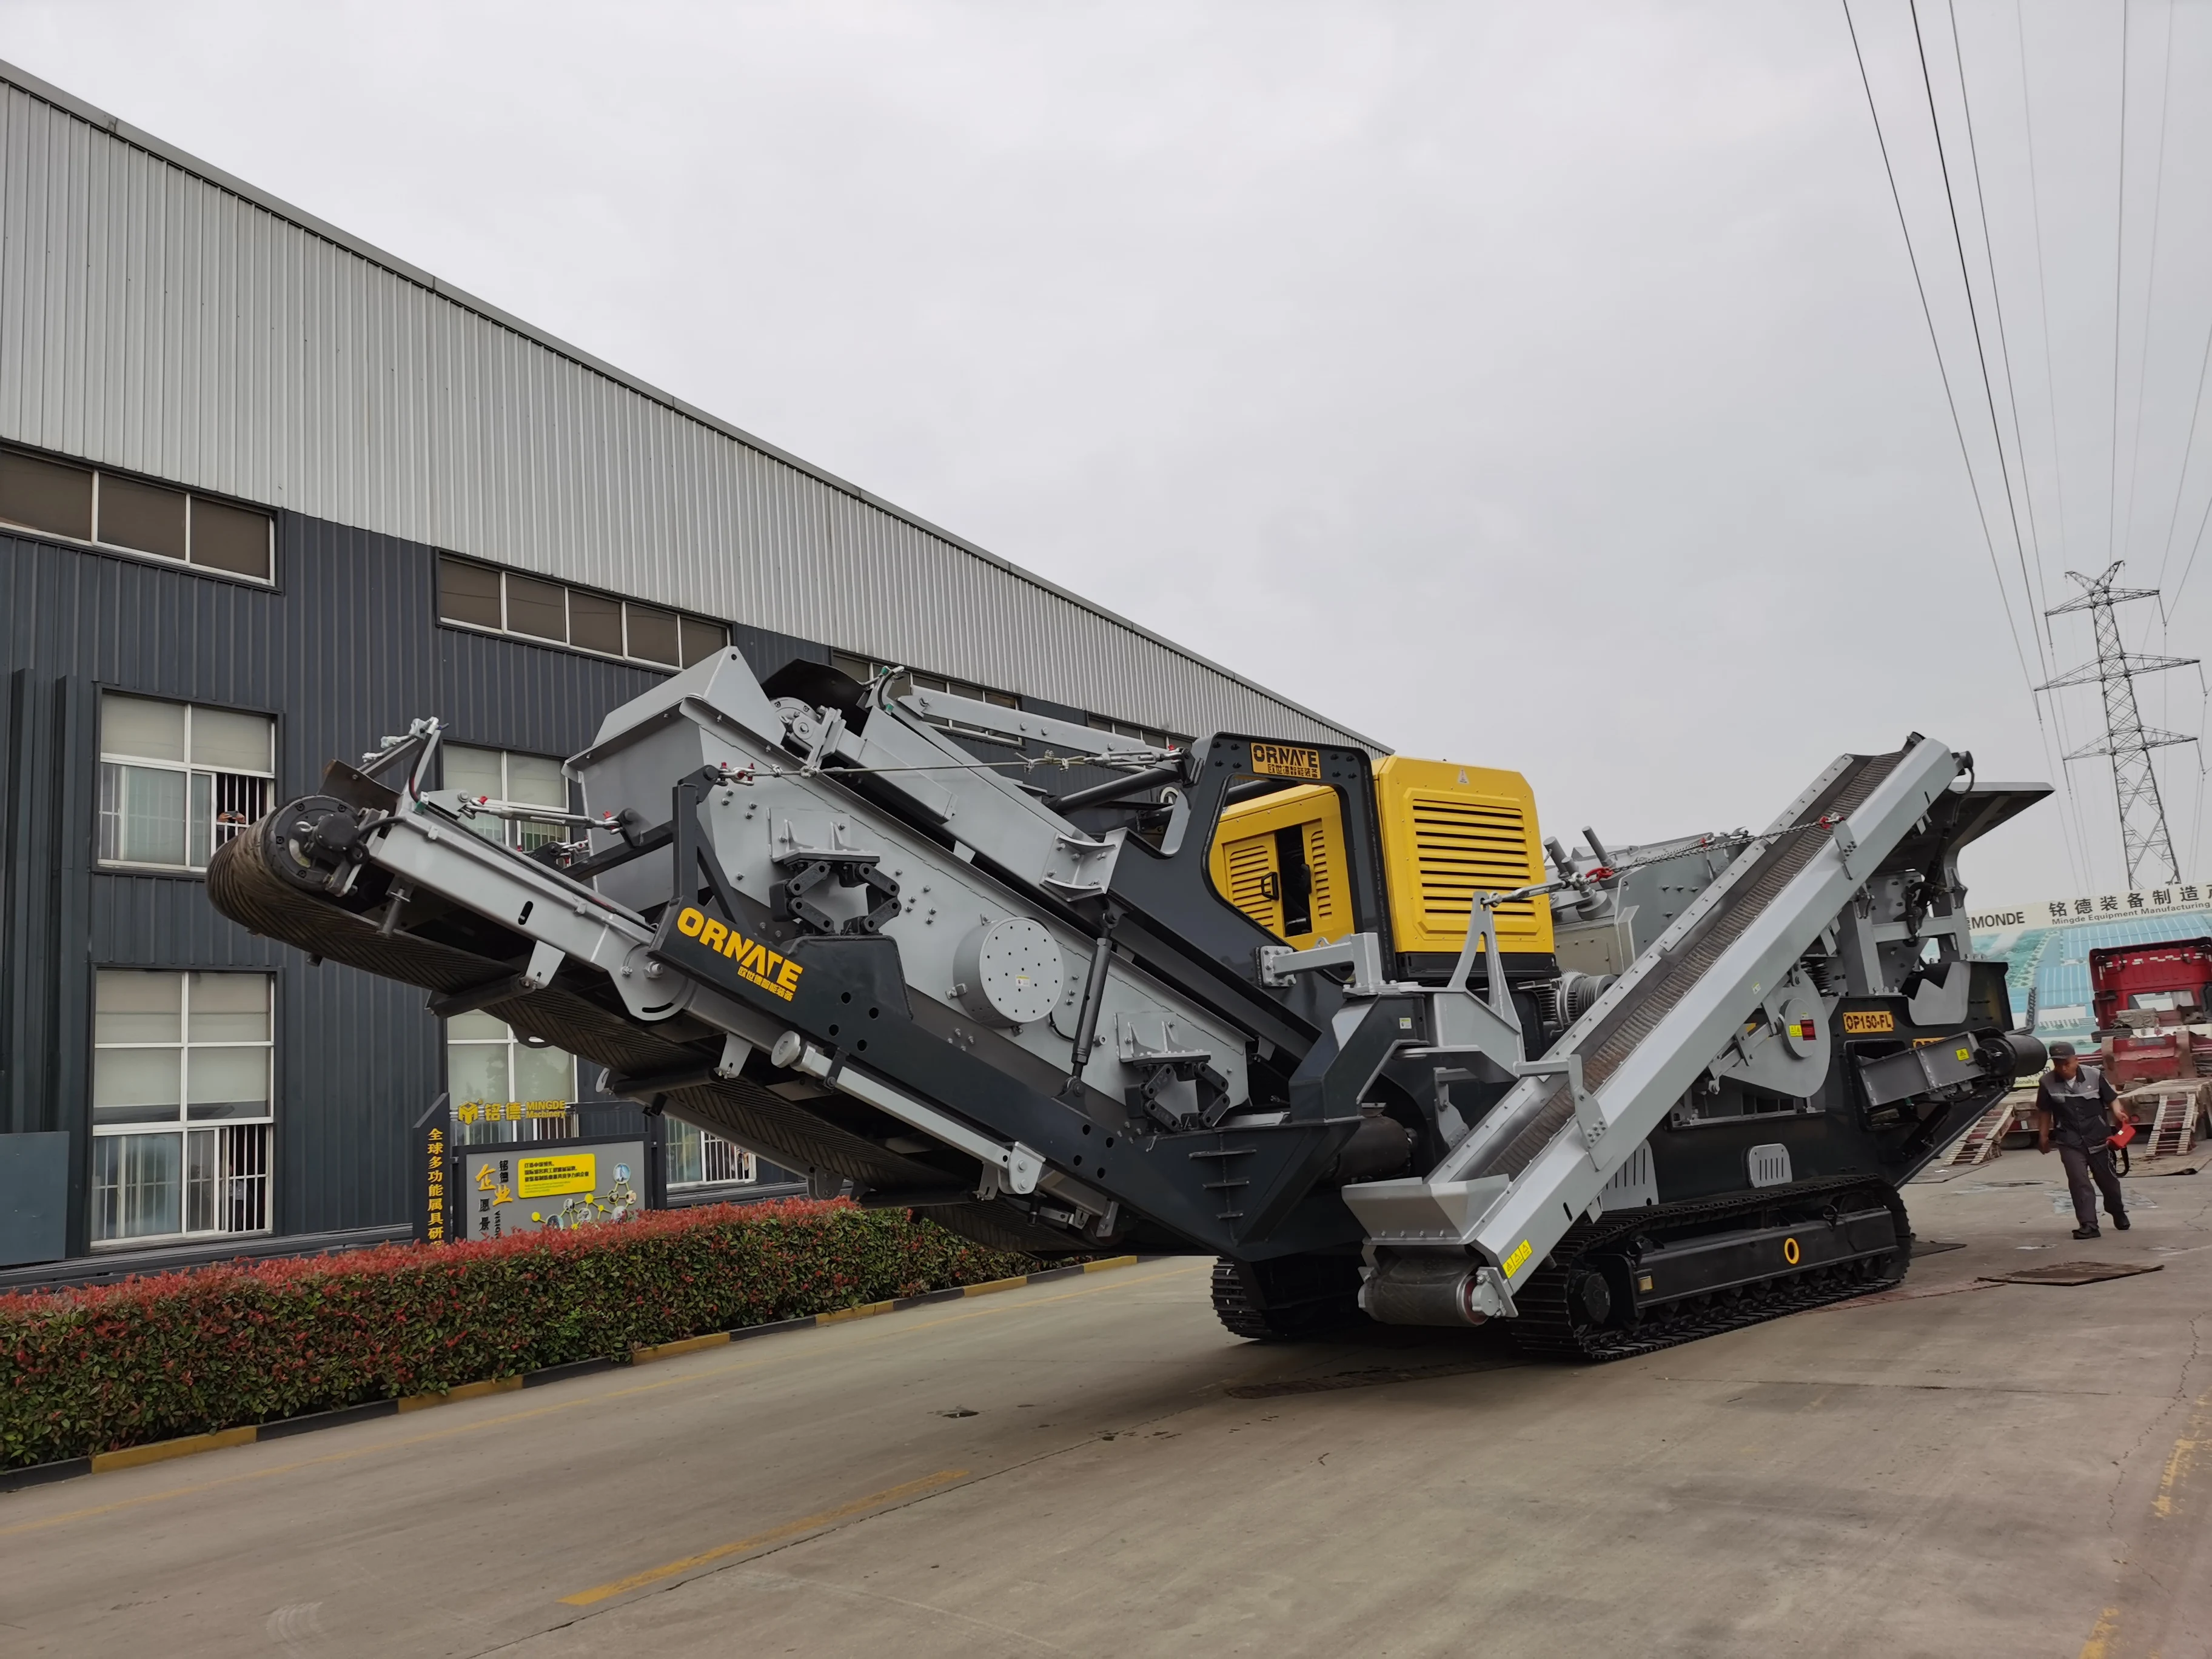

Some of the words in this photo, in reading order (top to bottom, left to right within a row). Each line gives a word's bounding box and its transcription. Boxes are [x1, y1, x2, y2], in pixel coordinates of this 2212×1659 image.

[1253, 745, 1318, 768] ORNATE
[1971, 911, 2025, 930] MONDE
[2051, 916, 2086, 925] Mingde
[2088, 910, 2138, 920] Equipment
[2140, 902, 2211, 916] Manufacturing
[677, 907, 804, 993] ORNATE
[1846, 1013, 1892, 1030] OP150-FL
[484, 1101, 521, 1122] 铭德
[525, 1100, 566, 1111] MINGDE
[525, 1110, 566, 1119] Machinery
[475, 1164, 513, 1207] 企业
